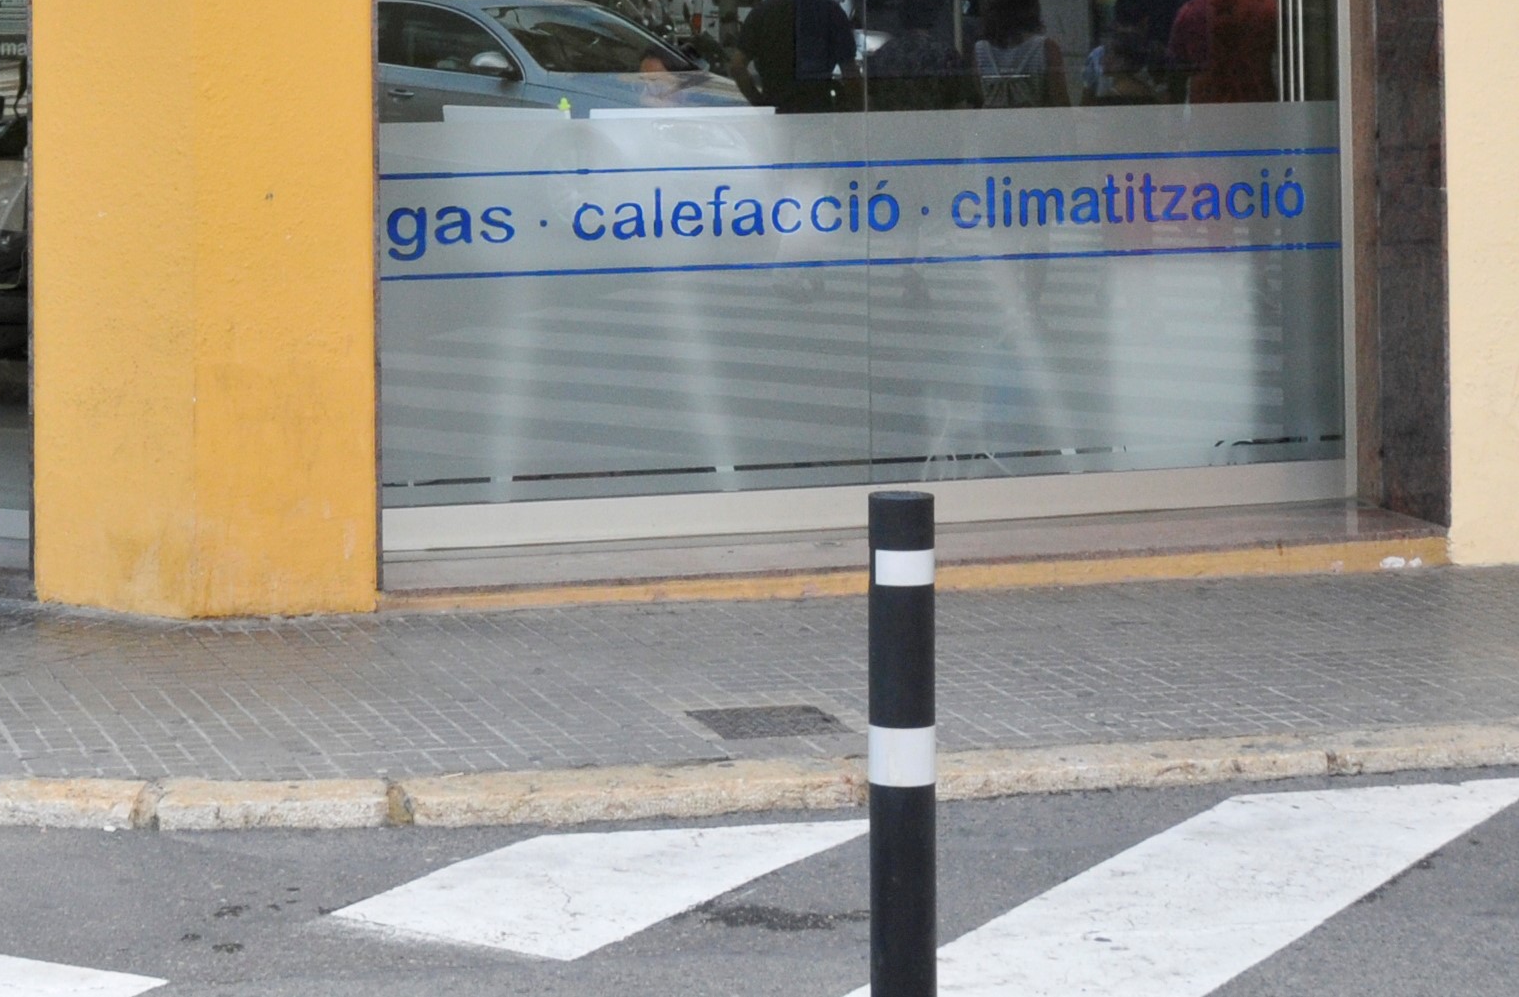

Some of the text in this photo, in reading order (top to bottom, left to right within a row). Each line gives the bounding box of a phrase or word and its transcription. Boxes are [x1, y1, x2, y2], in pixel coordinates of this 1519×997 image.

[385, 167, 1307, 261] gas calefacció climatització
